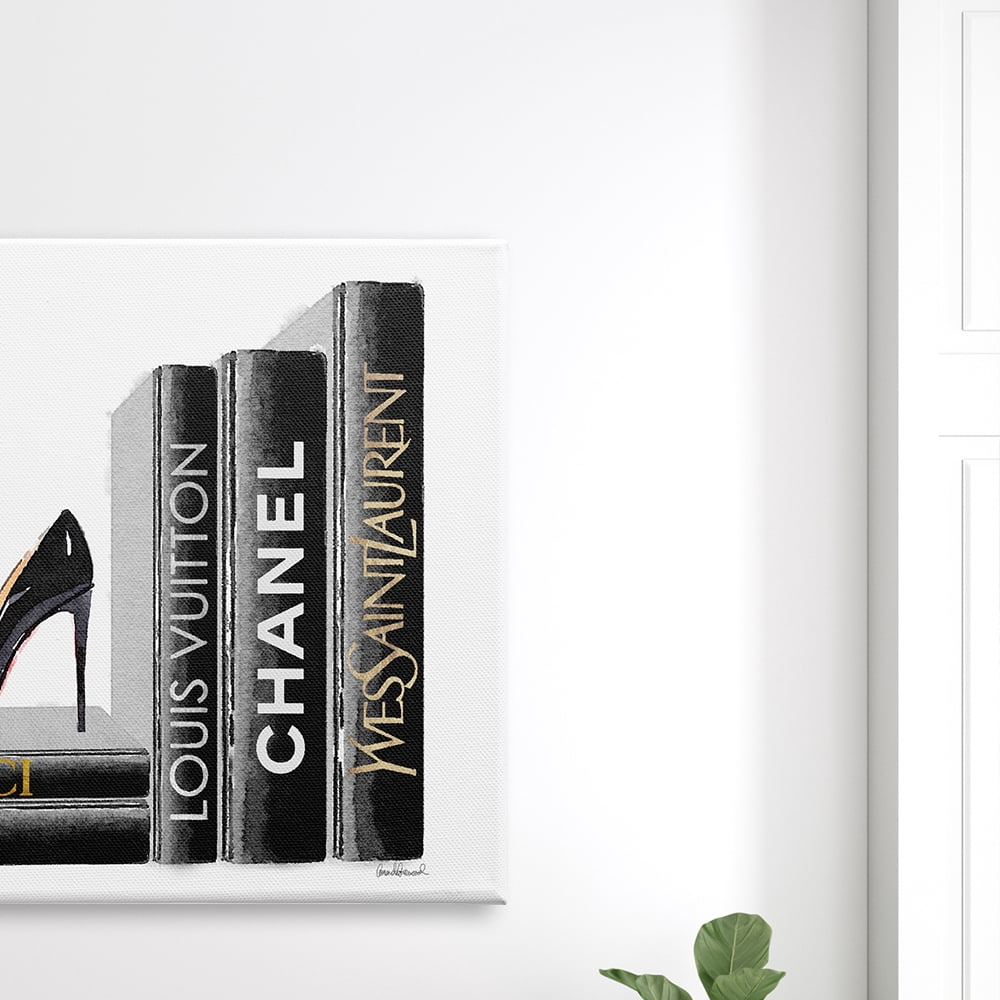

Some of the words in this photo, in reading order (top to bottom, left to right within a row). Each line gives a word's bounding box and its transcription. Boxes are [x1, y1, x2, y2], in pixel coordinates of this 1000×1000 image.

[169, 443, 209, 660] VUITTON
[256, 441, 306, 775] CHANEL
[169, 678, 209, 821] LOUIS
